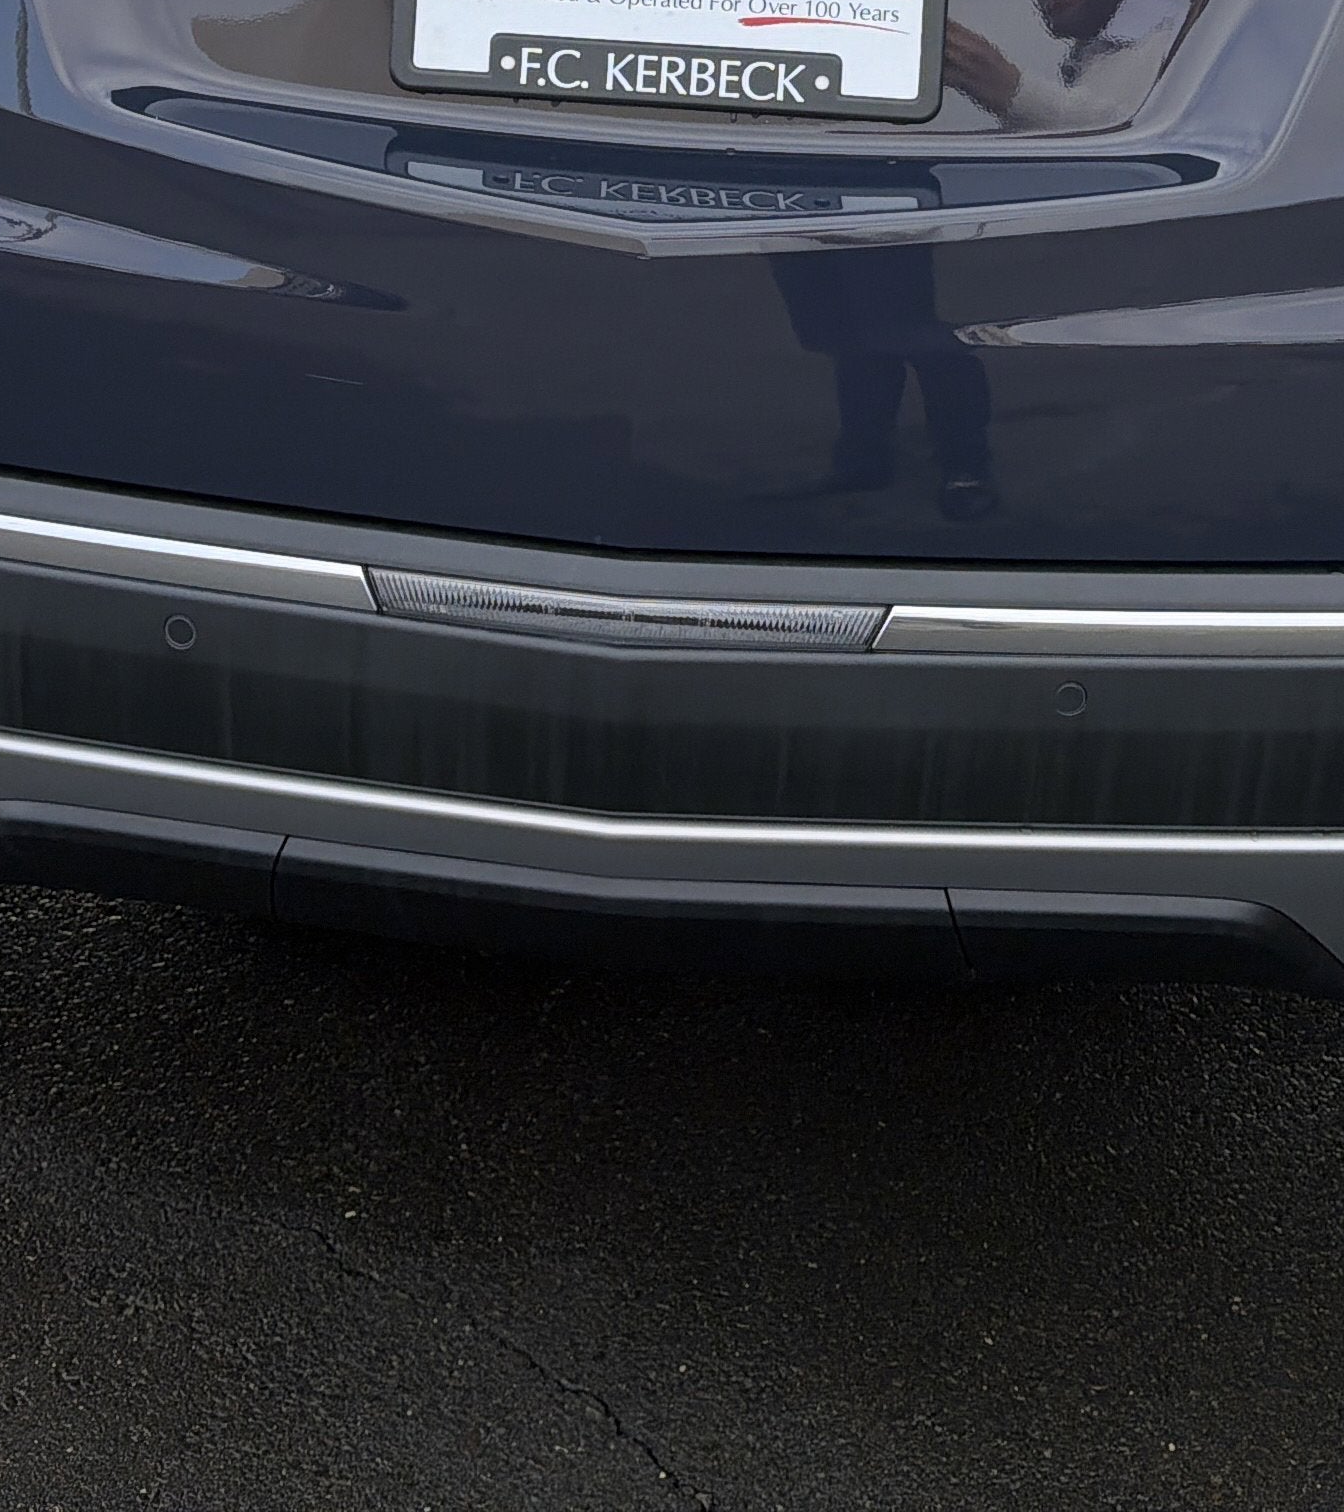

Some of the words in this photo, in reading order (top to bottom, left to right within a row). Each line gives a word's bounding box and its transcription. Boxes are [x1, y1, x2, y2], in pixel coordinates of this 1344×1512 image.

[805, 0, 842, 19] 100
[849, 2, 900, 23] Years
[519, 47, 589, 90] F.C.
[605, 52, 807, 104] KERBECK
